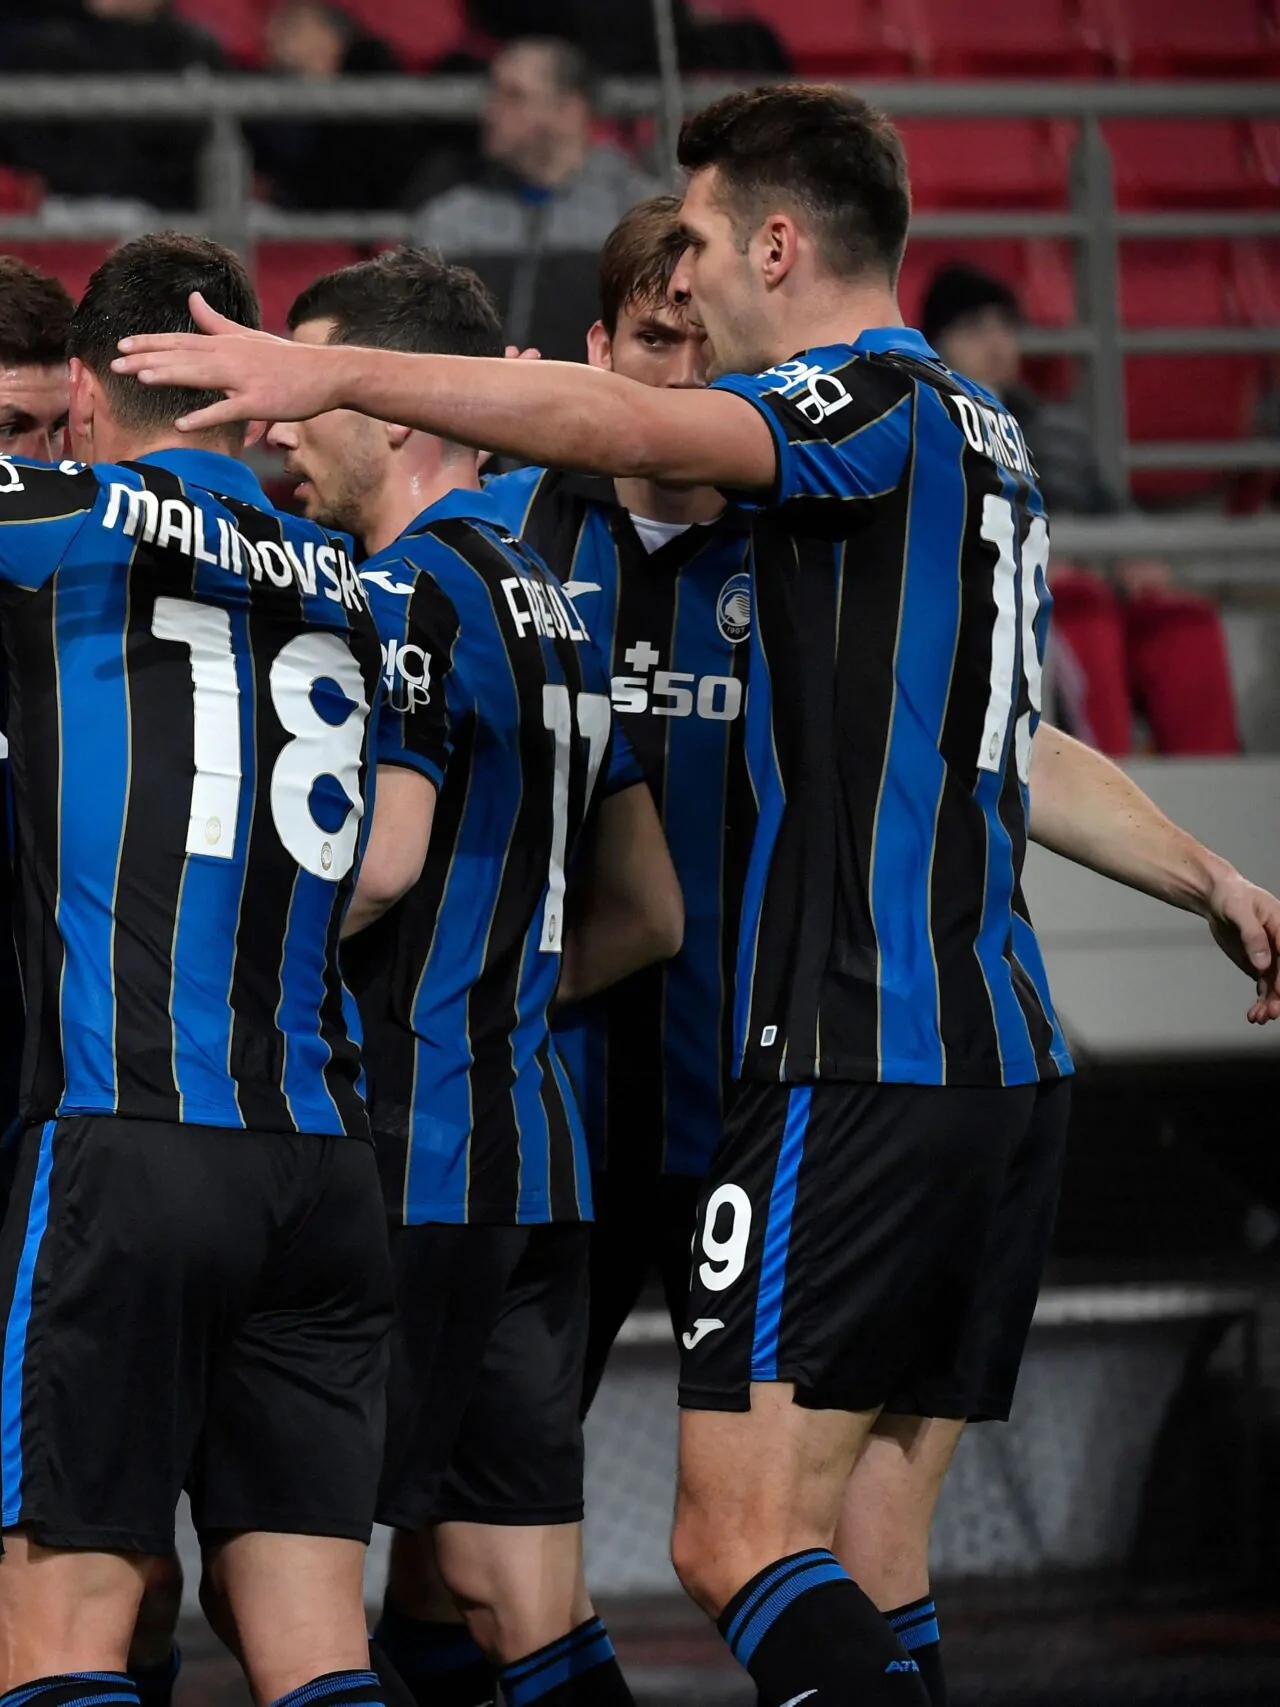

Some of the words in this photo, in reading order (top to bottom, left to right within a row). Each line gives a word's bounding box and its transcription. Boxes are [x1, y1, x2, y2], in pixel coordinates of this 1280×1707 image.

[610, 670, 749, 722] s50
[977, 493, 1053, 786] 19
[150, 596, 371, 882] 18
[690, 1182, 753, 1292] 9
